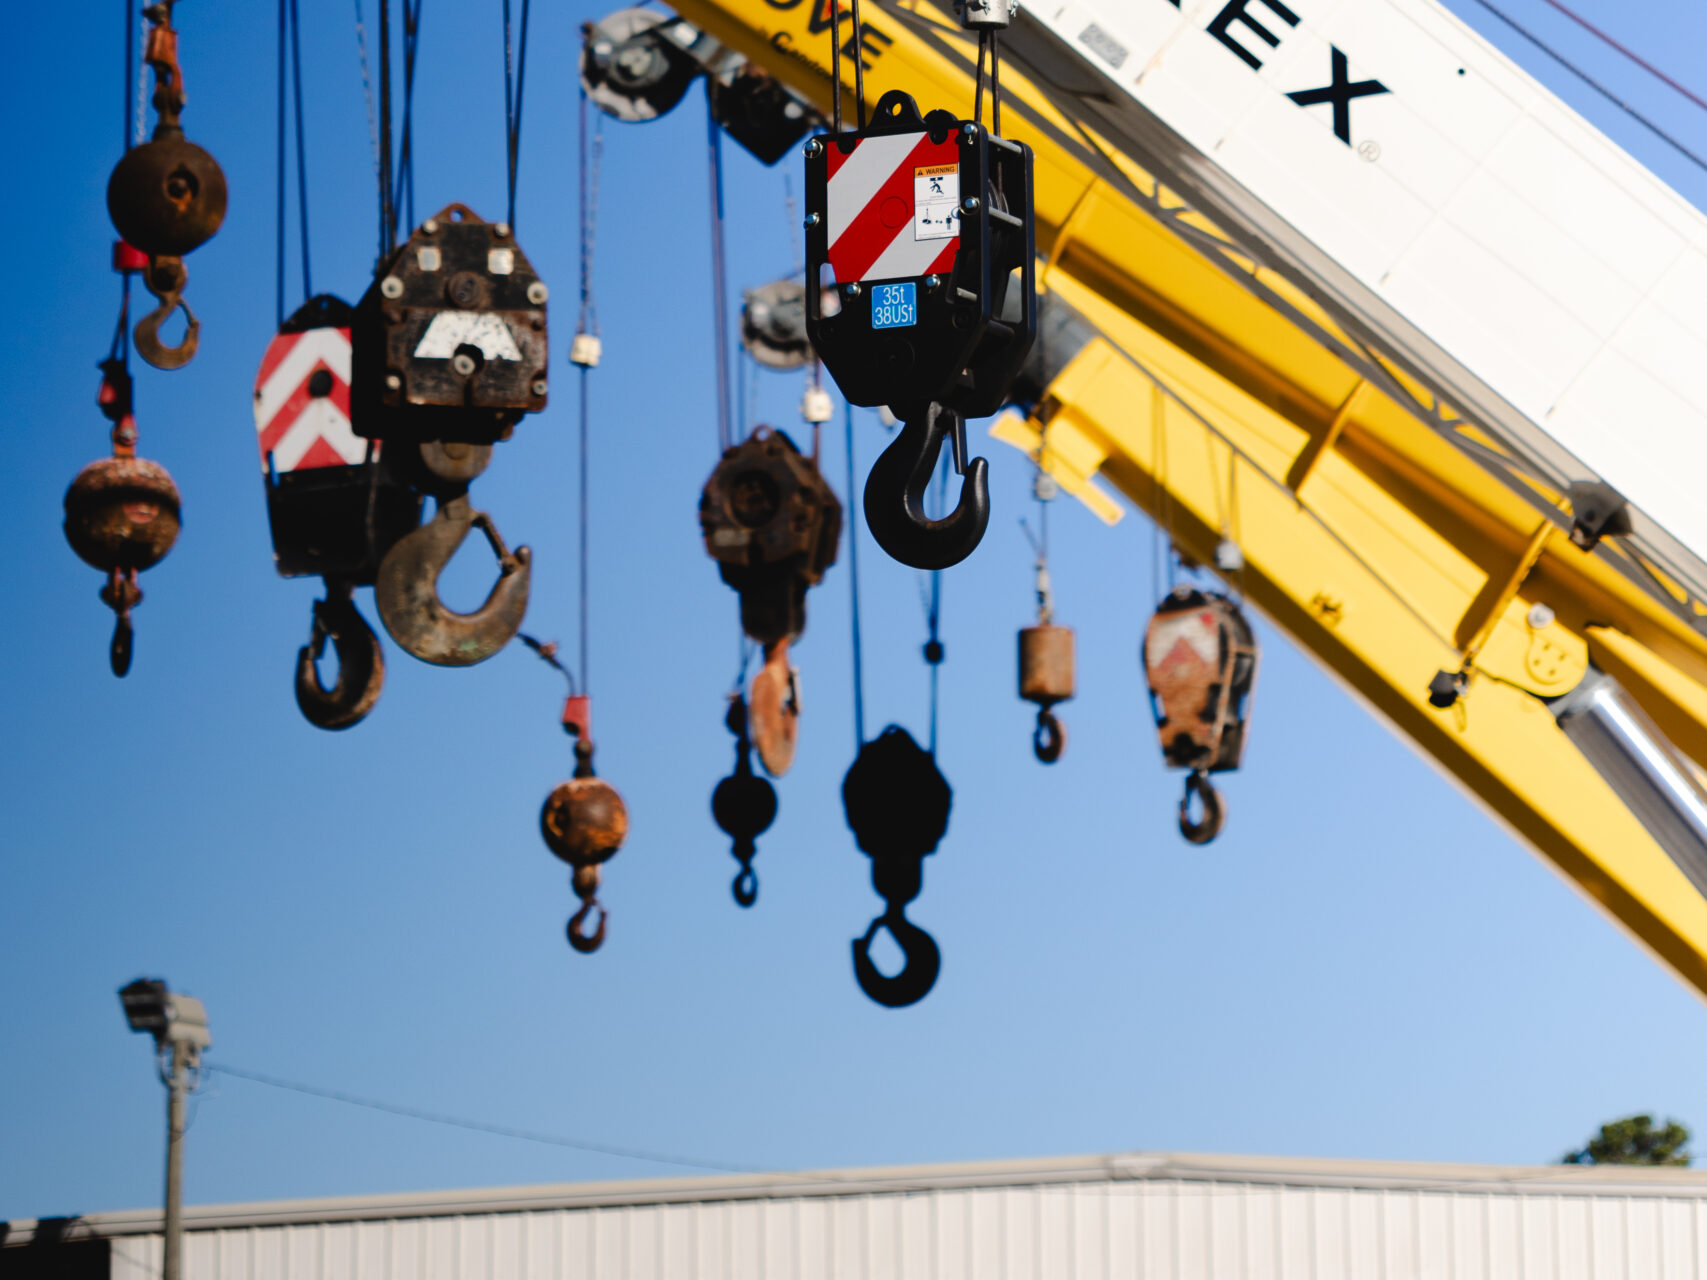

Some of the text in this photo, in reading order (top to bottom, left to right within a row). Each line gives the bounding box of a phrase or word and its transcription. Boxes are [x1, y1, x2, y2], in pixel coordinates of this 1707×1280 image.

[925, 166, 955, 175] WARNING
[883, 285, 905, 305] 35t
[875, 304, 914, 325] 38USt
